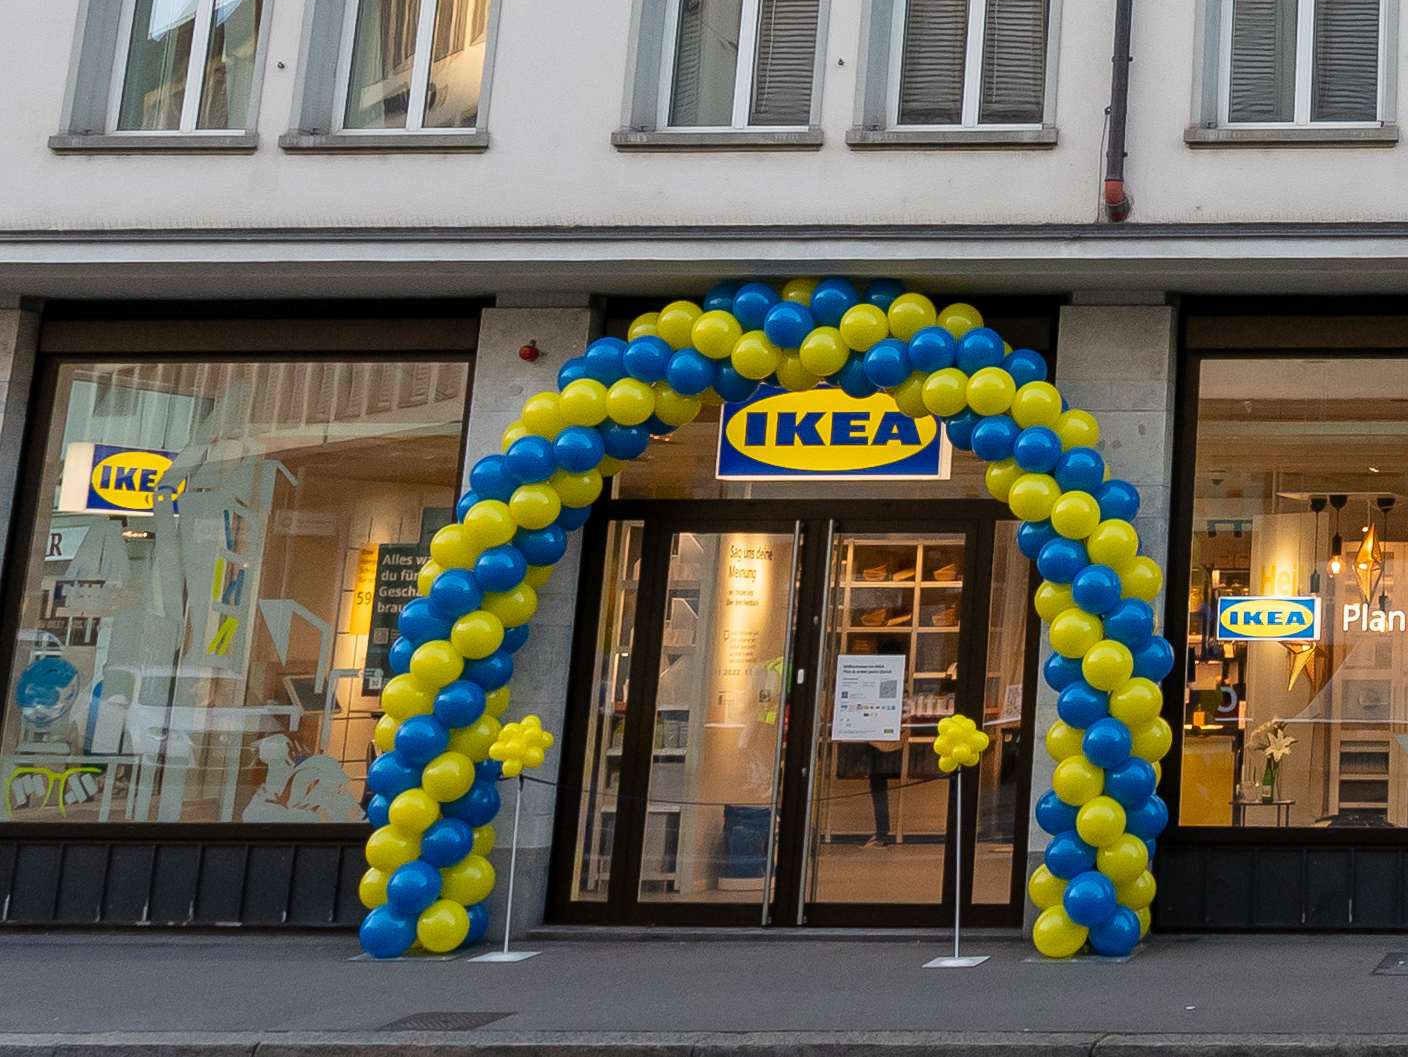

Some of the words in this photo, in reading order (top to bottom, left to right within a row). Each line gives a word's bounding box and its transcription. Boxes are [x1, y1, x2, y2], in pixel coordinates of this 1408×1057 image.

[744, 411, 923, 446] IKEA
[99, 465, 160, 493] IKE
[382, 554, 413, 566] Alles
[381, 570, 397, 581] du
[1229, 611, 1306, 626] IKEA
[1343, 603, 1406, 632] Plan
